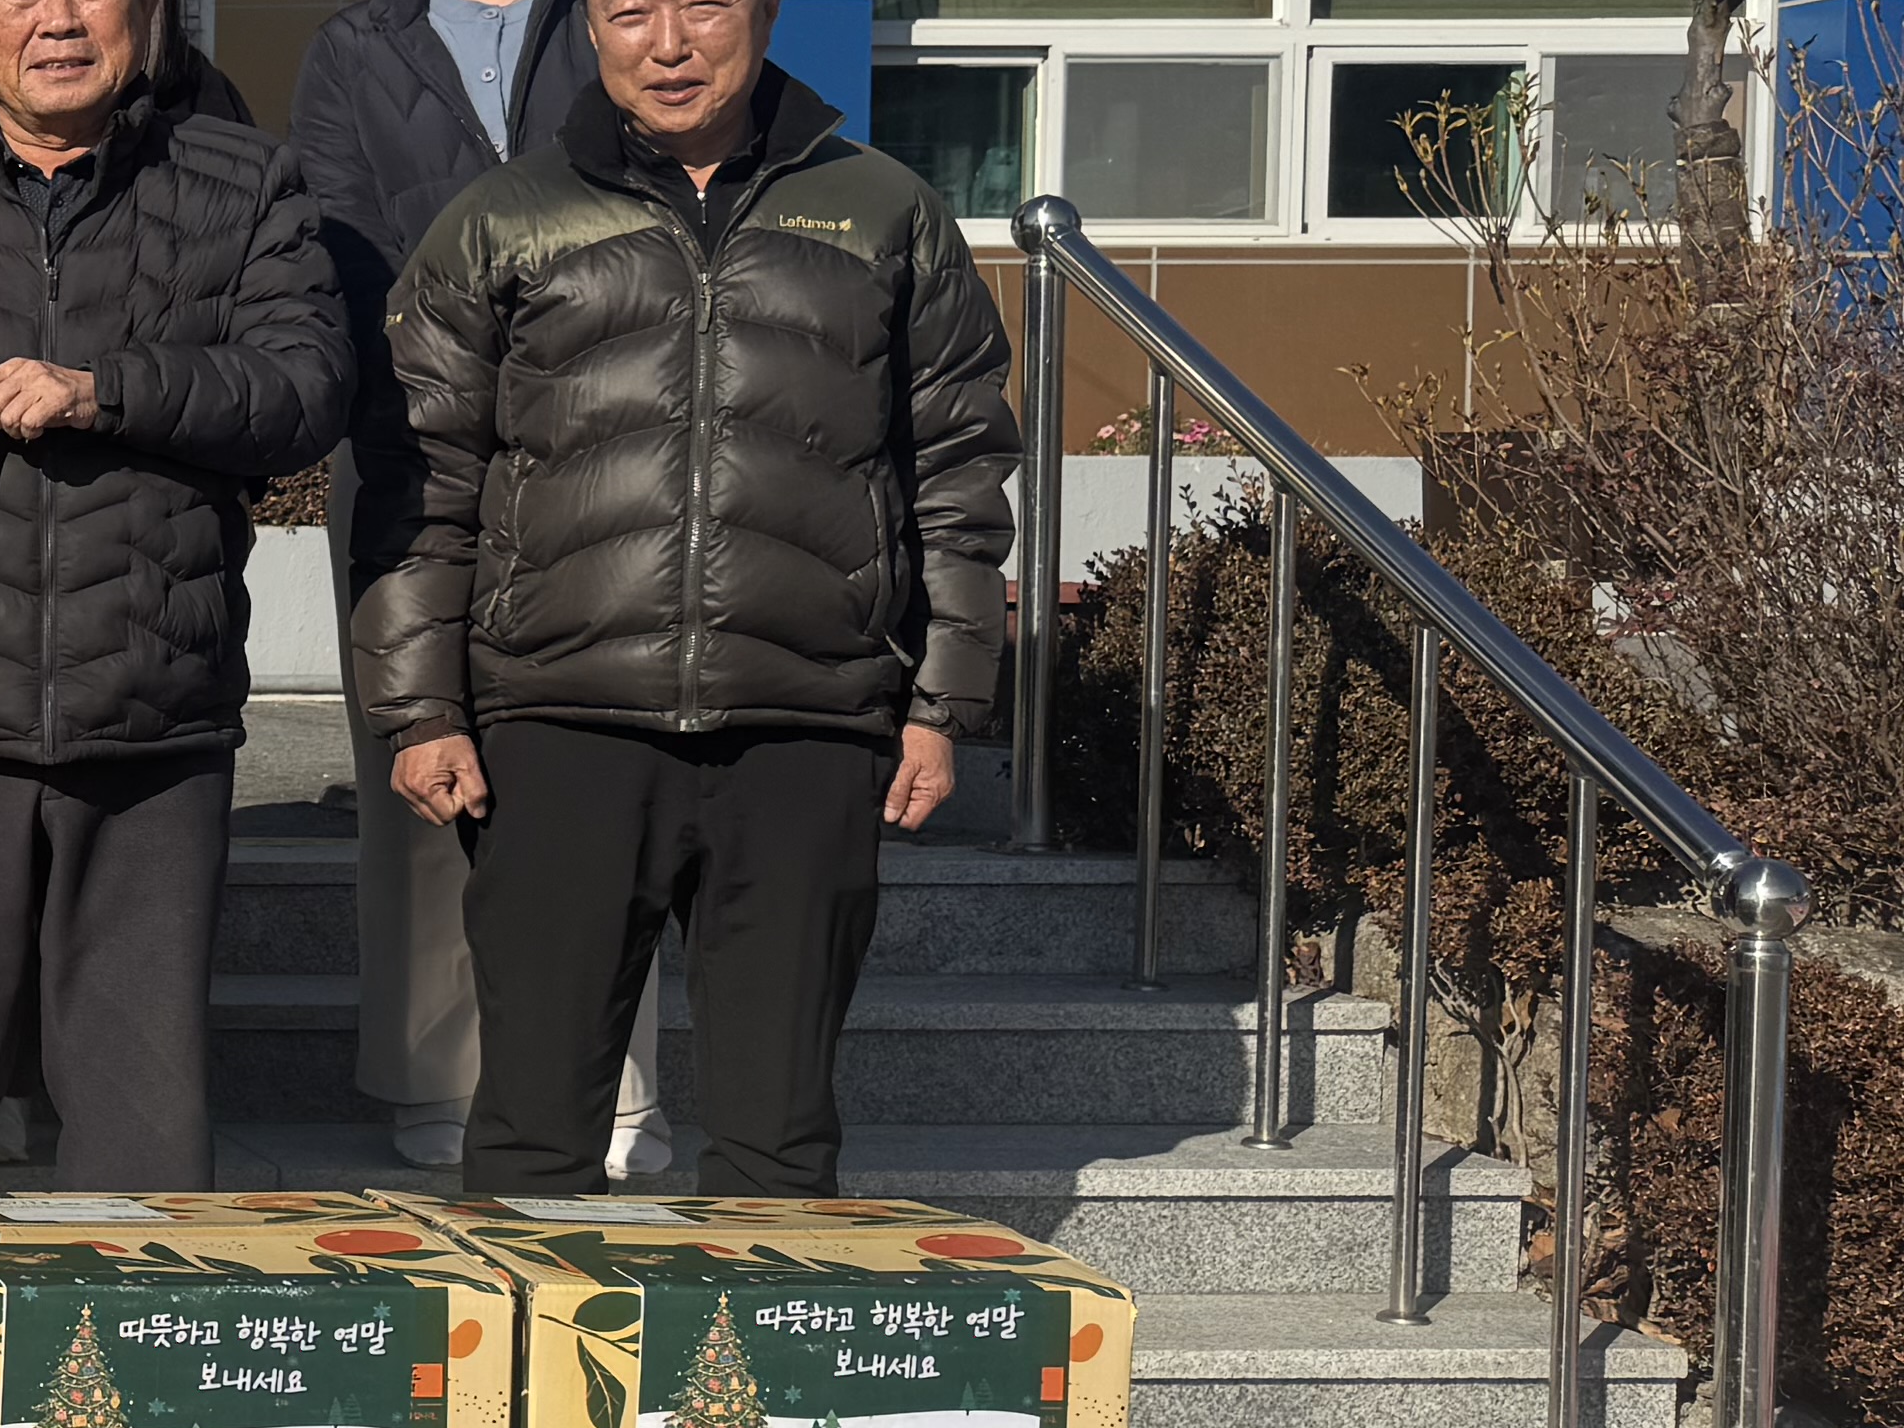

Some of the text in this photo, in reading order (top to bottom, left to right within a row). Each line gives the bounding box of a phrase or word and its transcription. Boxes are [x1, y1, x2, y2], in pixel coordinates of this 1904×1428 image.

[778, 213, 836, 231] Lafuma
[754, 1299, 1025, 1341] 따뜻하고 행복한 연말
[832, 1348, 942, 1380] 보내세요
